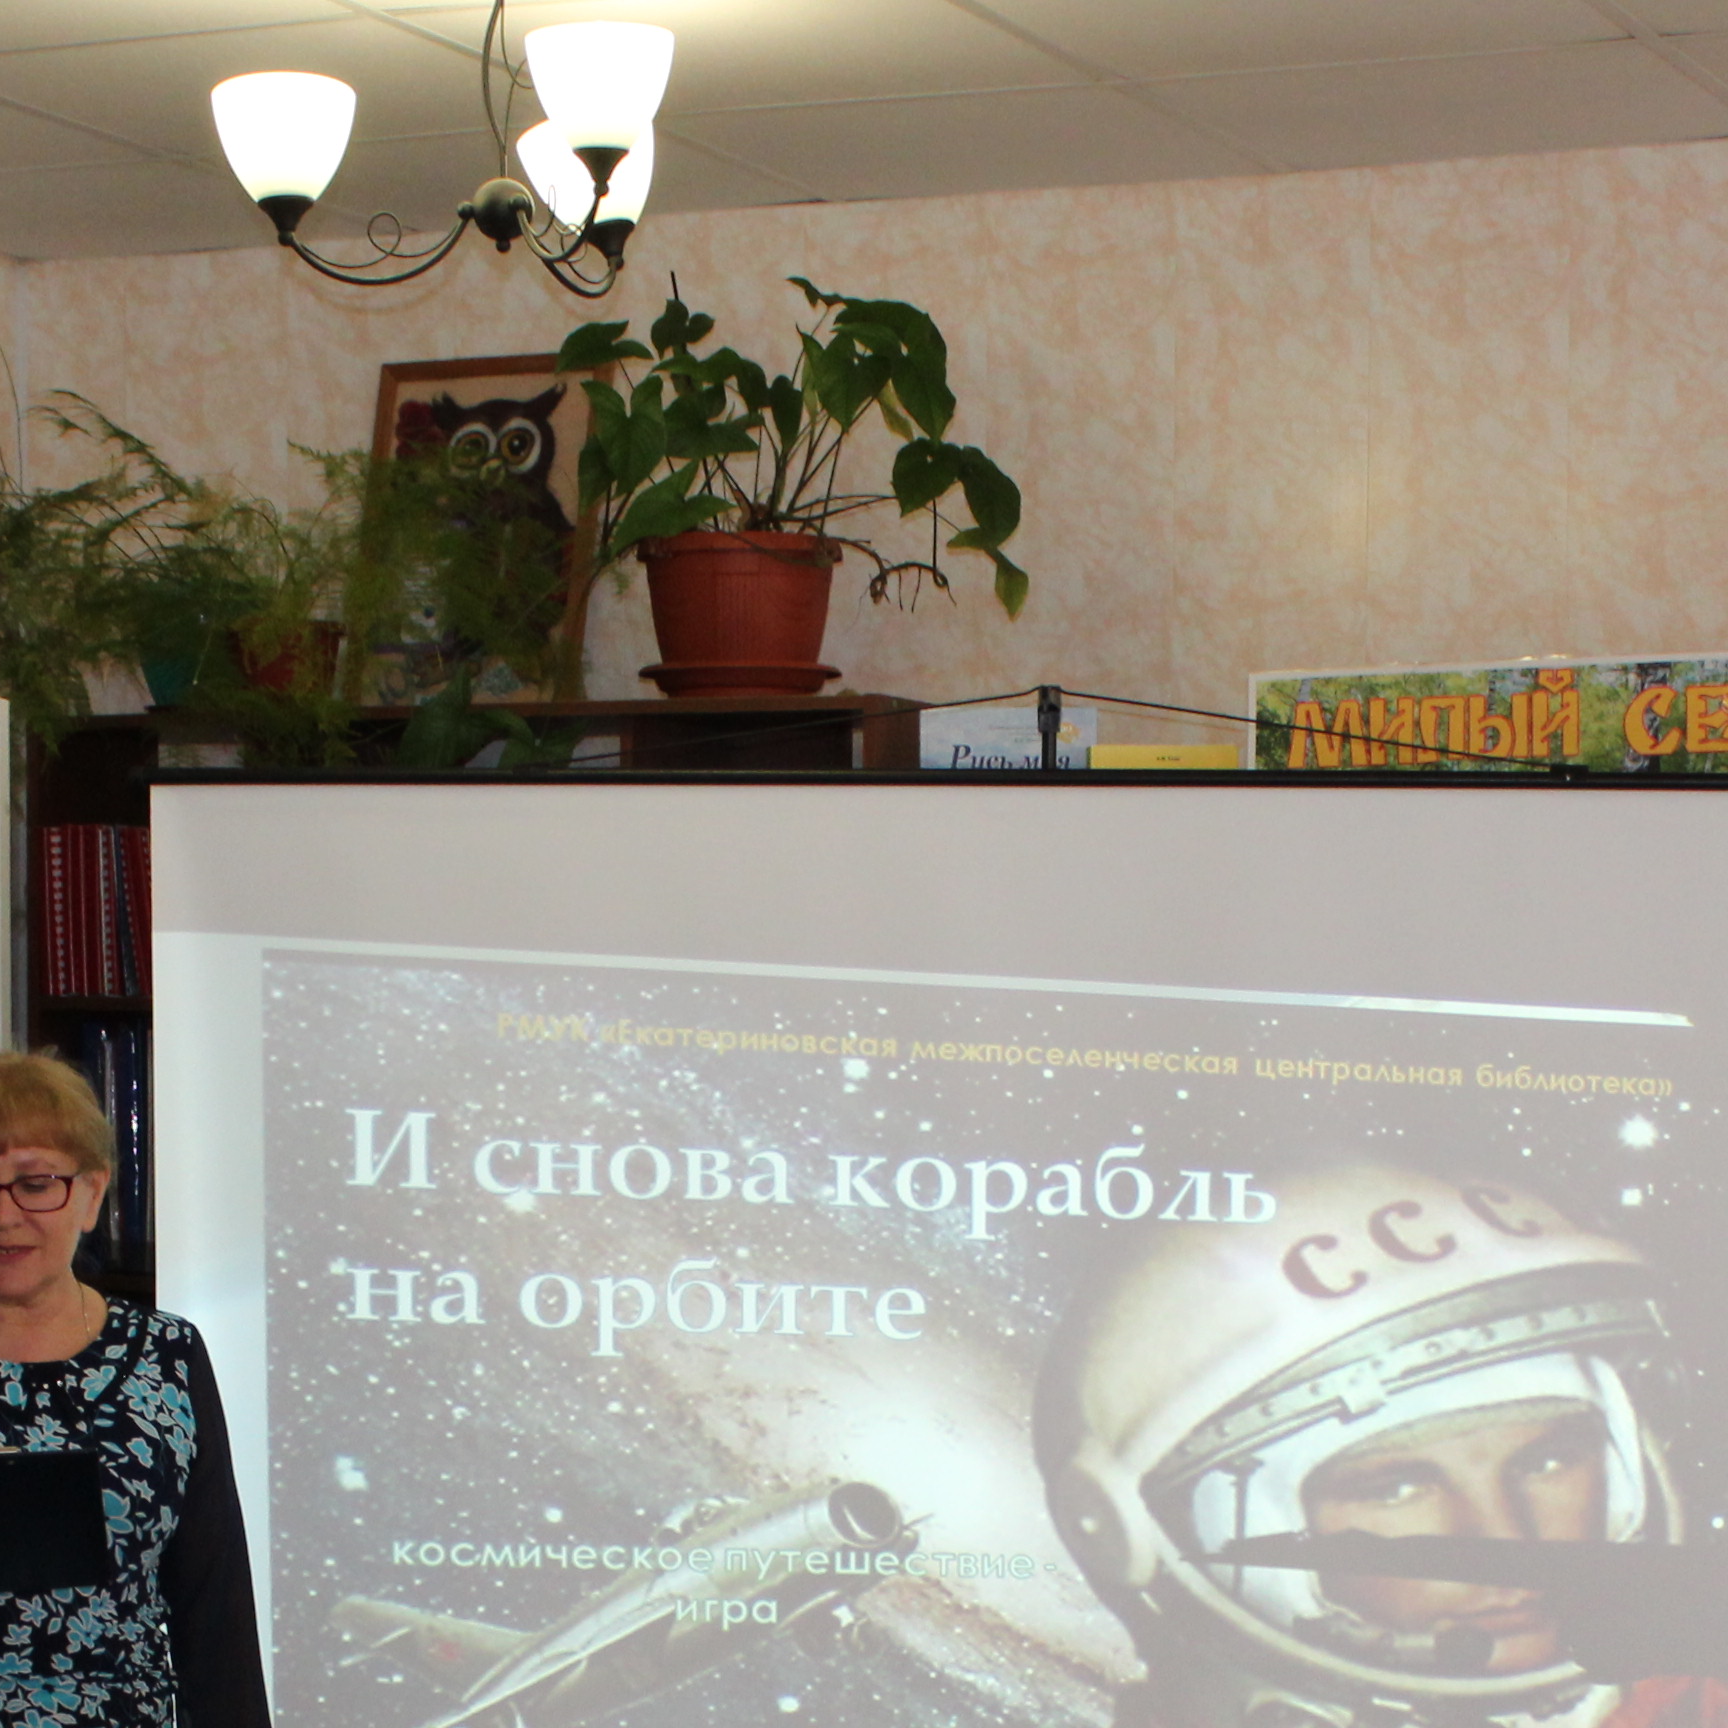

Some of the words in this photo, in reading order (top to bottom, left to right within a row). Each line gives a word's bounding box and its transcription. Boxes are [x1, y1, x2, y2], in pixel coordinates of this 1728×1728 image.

[1288, 666, 1580, 769] МИЛЫЙ
[909, 1041, 1240, 1077] межпоселенческая
[1254, 1057, 1464, 1089] центральная
[1475, 1063, 1673, 1098] библиотека»
[345, 1107, 438, 1191] И
[473, 1137, 795, 1206] снова
[827, 1141, 1278, 1242] корабль
[345, 1265, 485, 1326] на
[518, 1257, 928, 1358] орбите
[391, 1538, 714, 1573] космическое
[724, 1544, 1035, 1580] путешествие
[674, 1592, 779, 1631] игра
